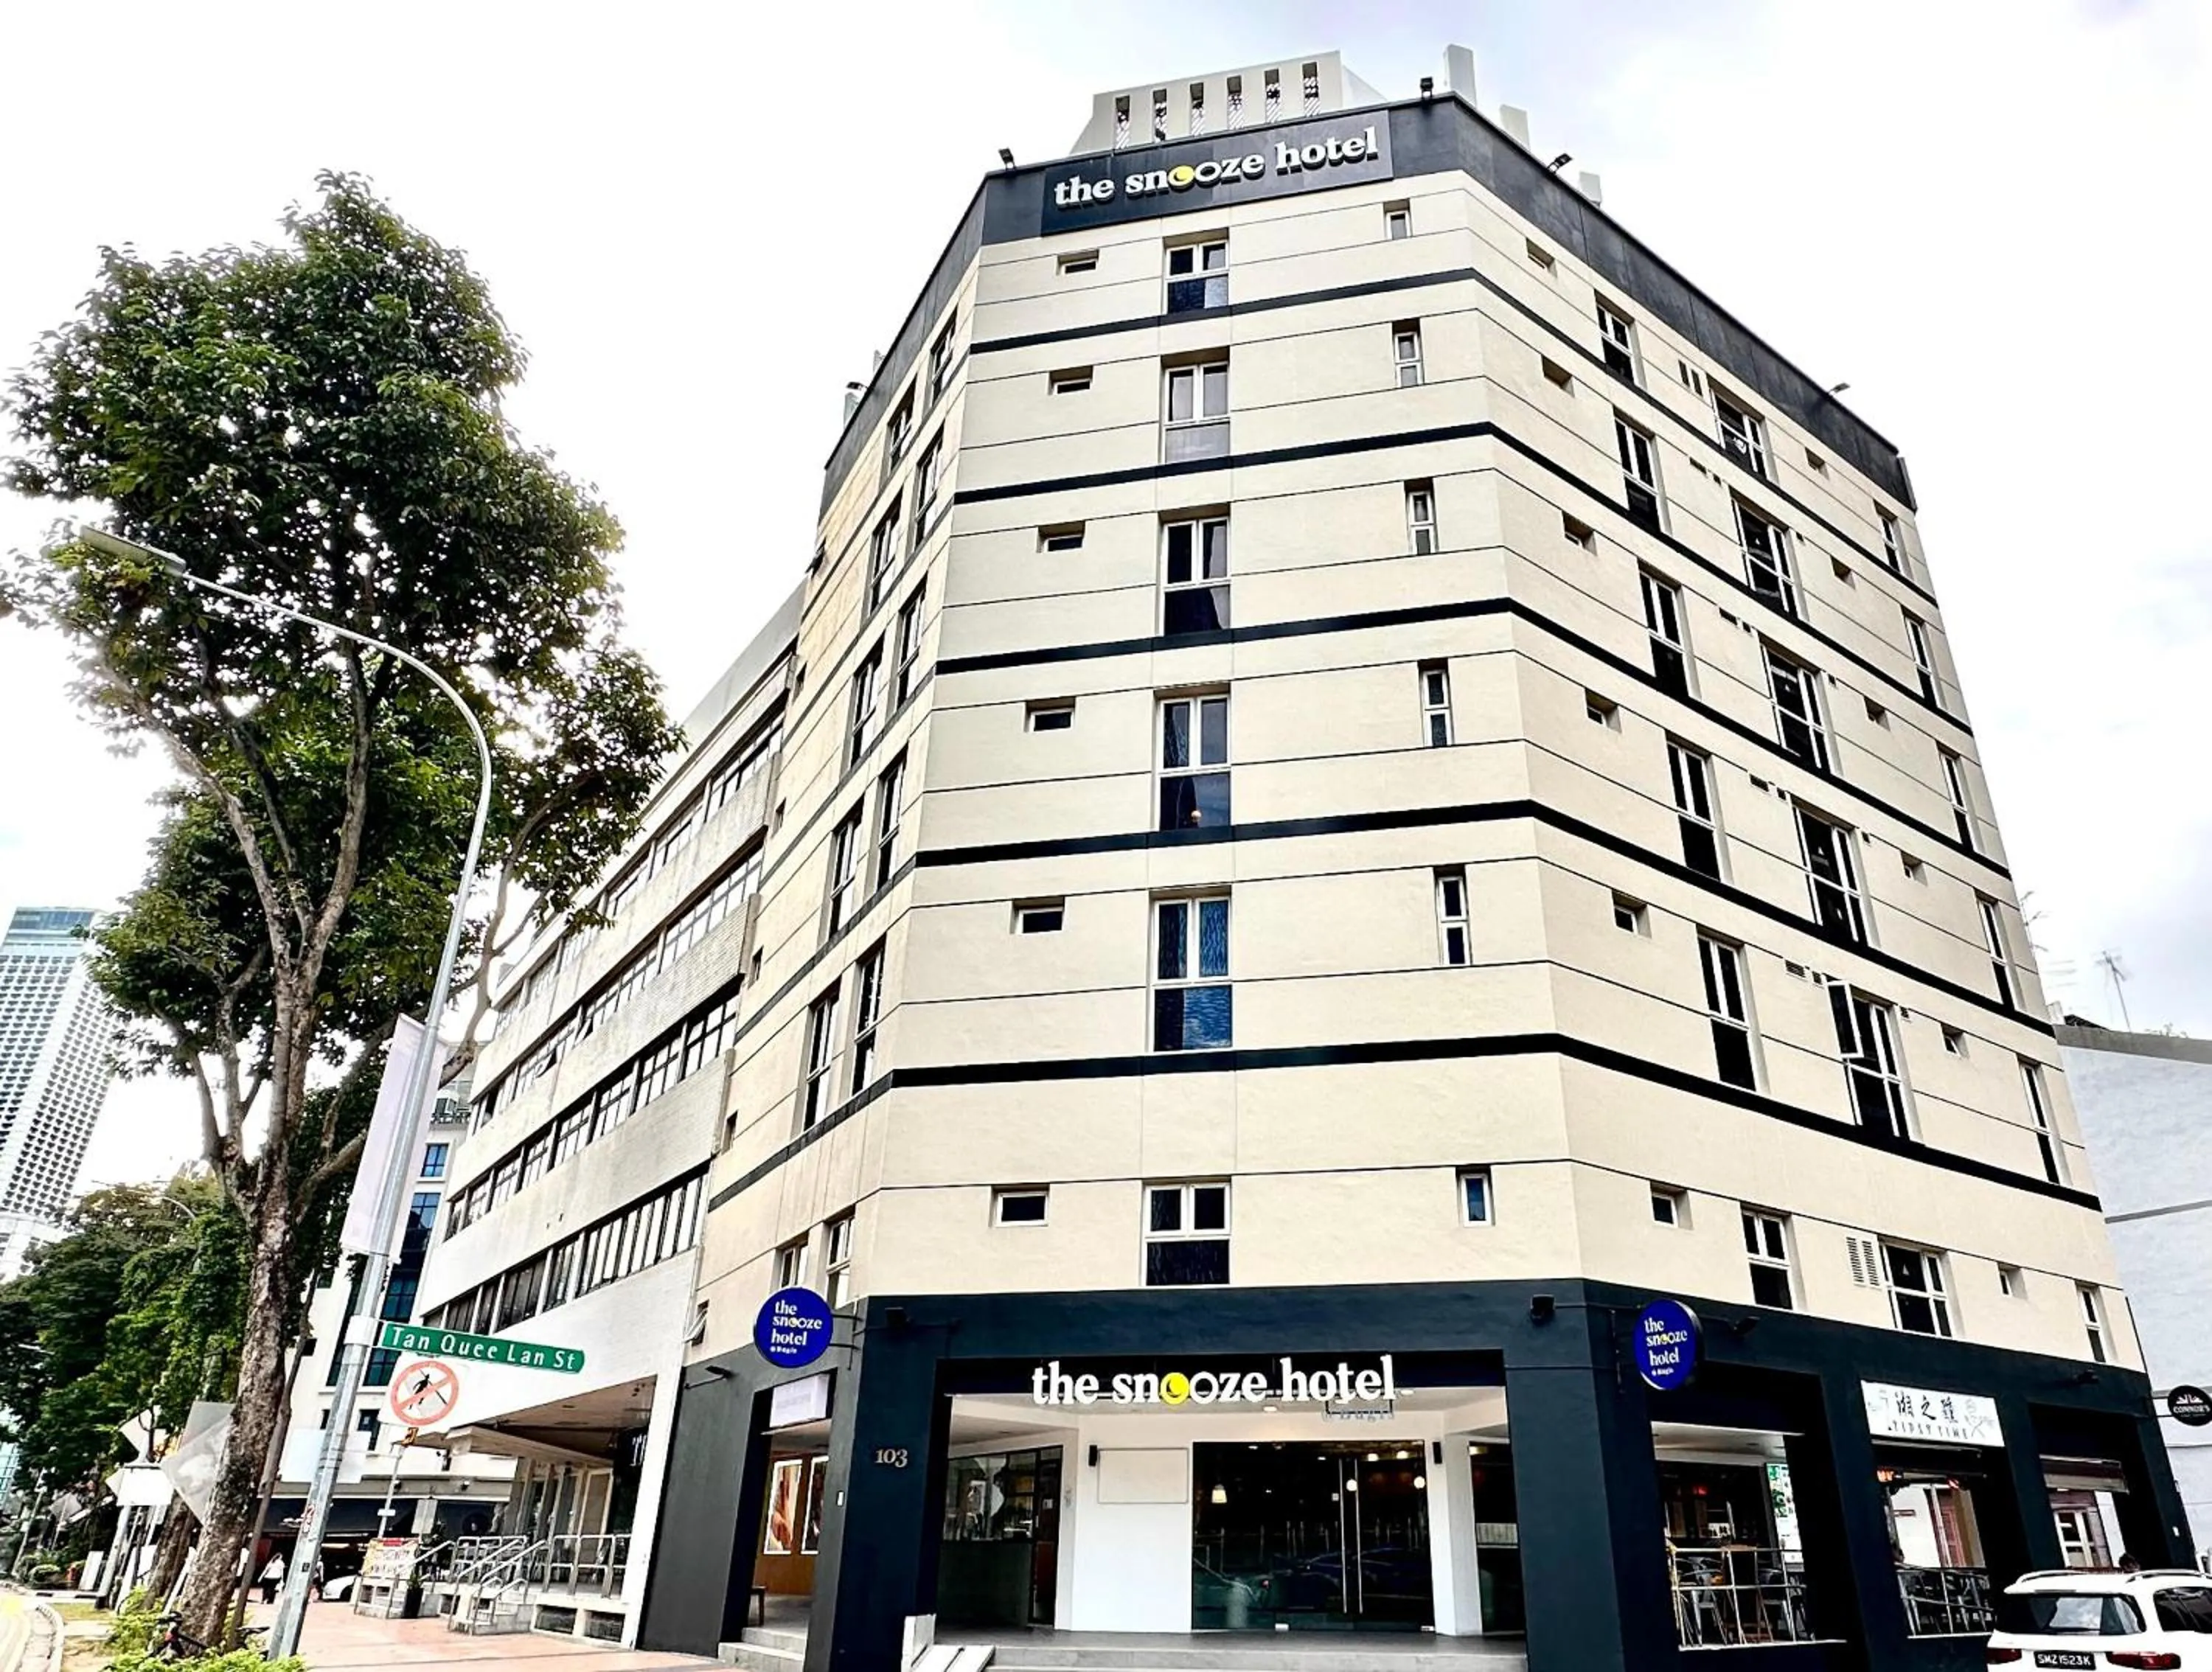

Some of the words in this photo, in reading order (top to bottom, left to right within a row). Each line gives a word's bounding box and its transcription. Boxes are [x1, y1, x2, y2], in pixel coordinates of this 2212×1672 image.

[1054, 176, 1114, 206] the
[1125, 154, 1265, 192] snooze
[1273, 125, 1380, 170] hotel
[775, 1300, 798, 1316] the
[772, 1316, 823, 1329] snooze
[1644, 1317, 1665, 1334] the
[771, 1328, 807, 1346] hotel
[1646, 1330, 1688, 1347] snooze
[392, 1326, 430, 1350] Tan
[440, 1334, 498, 1359] Quee
[507, 1343, 545, 1365] Lan
[554, 1350, 575, 1370] St
[1648, 1346, 1680, 1367] hotel
[1032, 1361, 1099, 1404] the
[1112, 1372, 1267, 1404] snooze
[1280, 1355, 1396, 1404] hotel
[874, 1448, 908, 1469] 103
